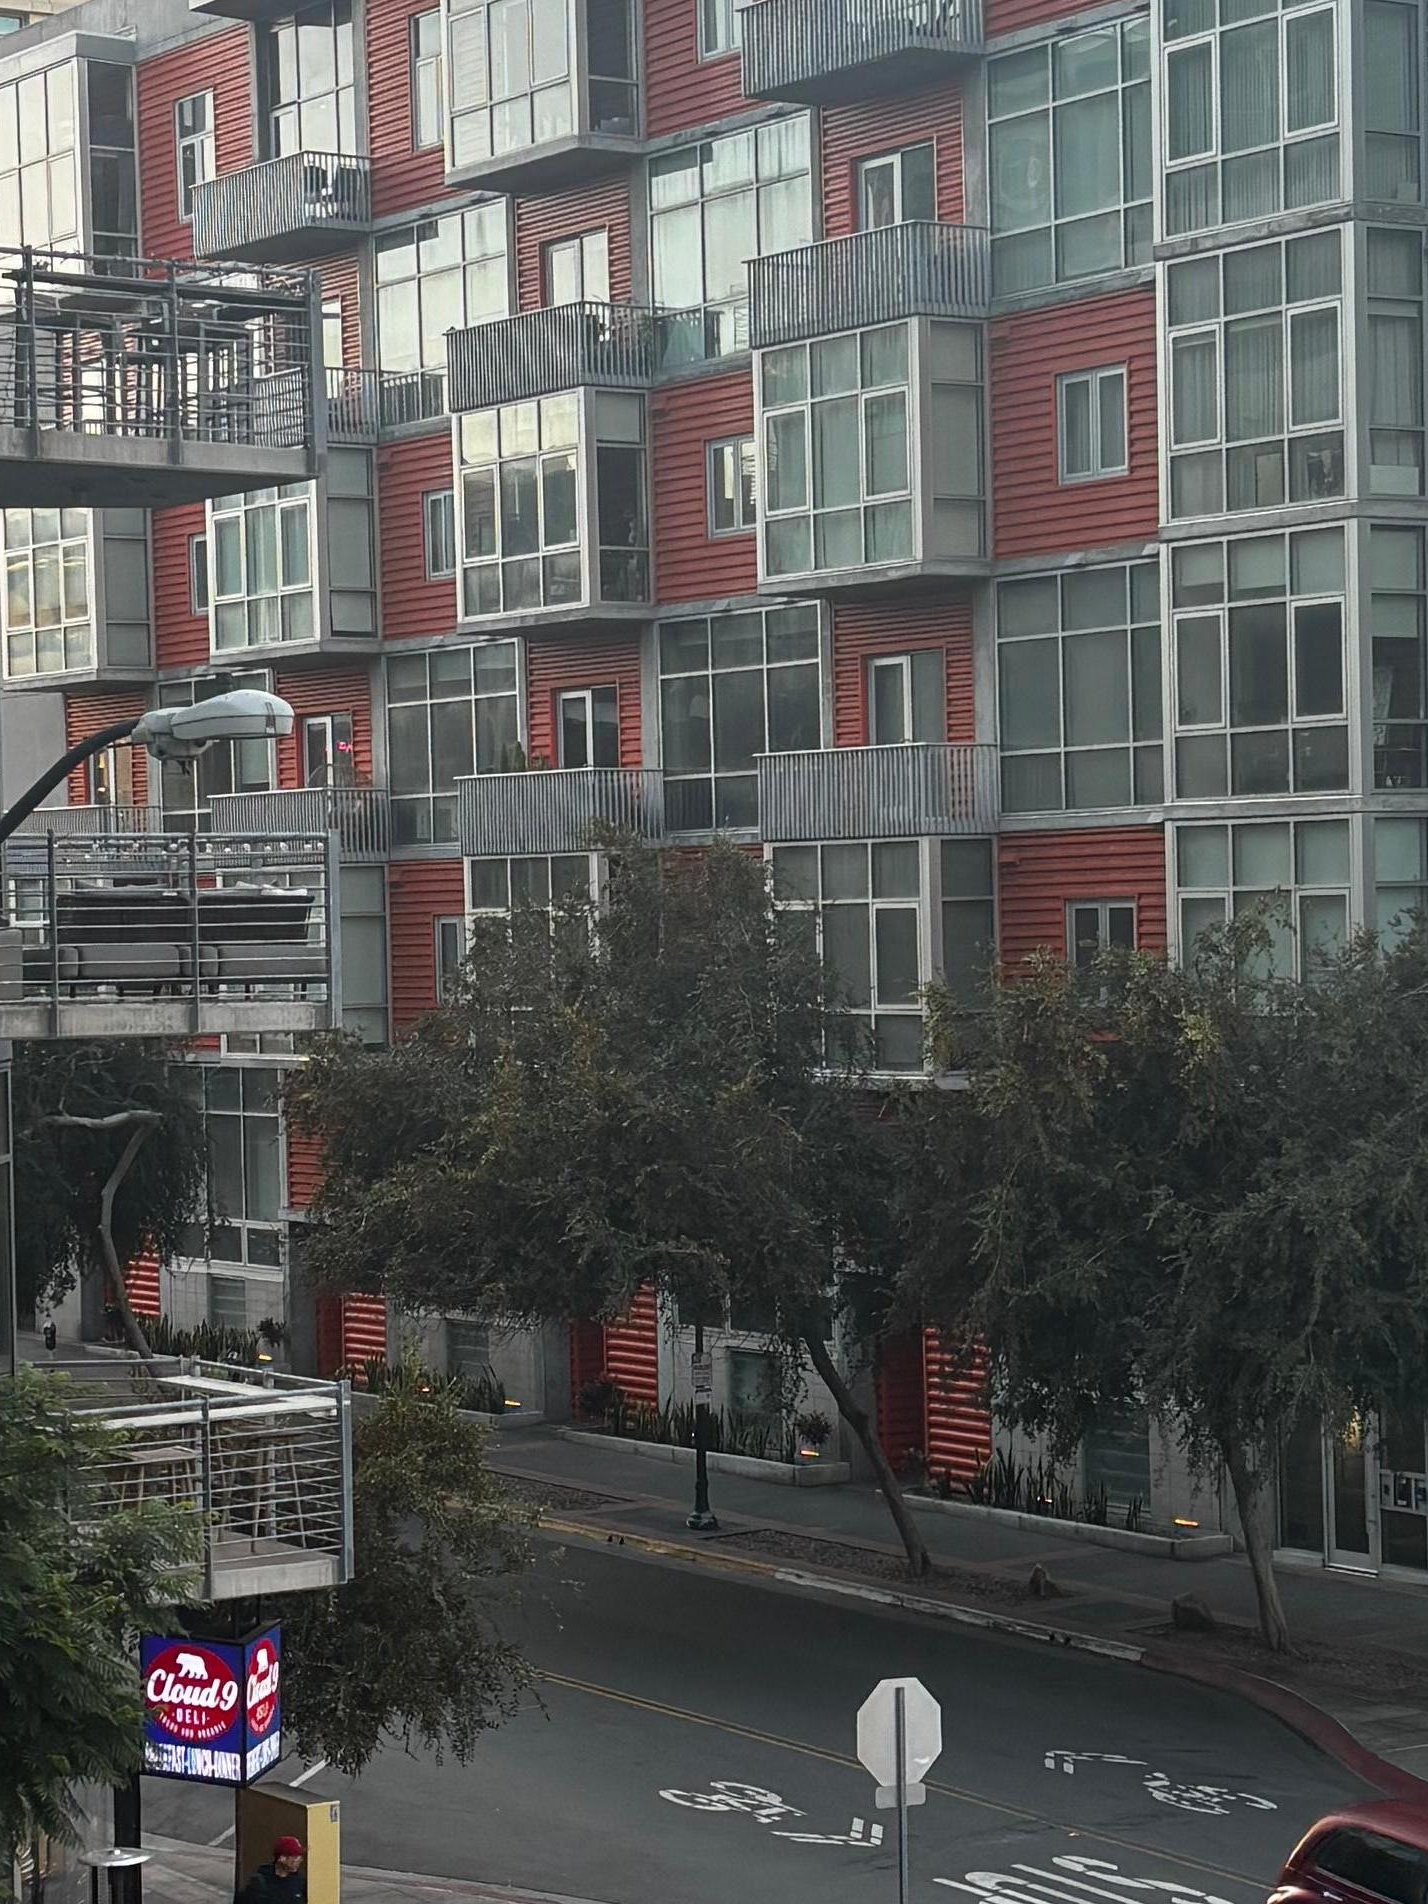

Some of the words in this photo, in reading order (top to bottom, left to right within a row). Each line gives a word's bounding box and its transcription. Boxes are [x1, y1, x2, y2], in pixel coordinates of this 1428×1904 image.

[146, 1668, 220, 1708] Cloud
[219, 1680, 238, 1711] 9
[176, 1707, 206, 1725] DELI
